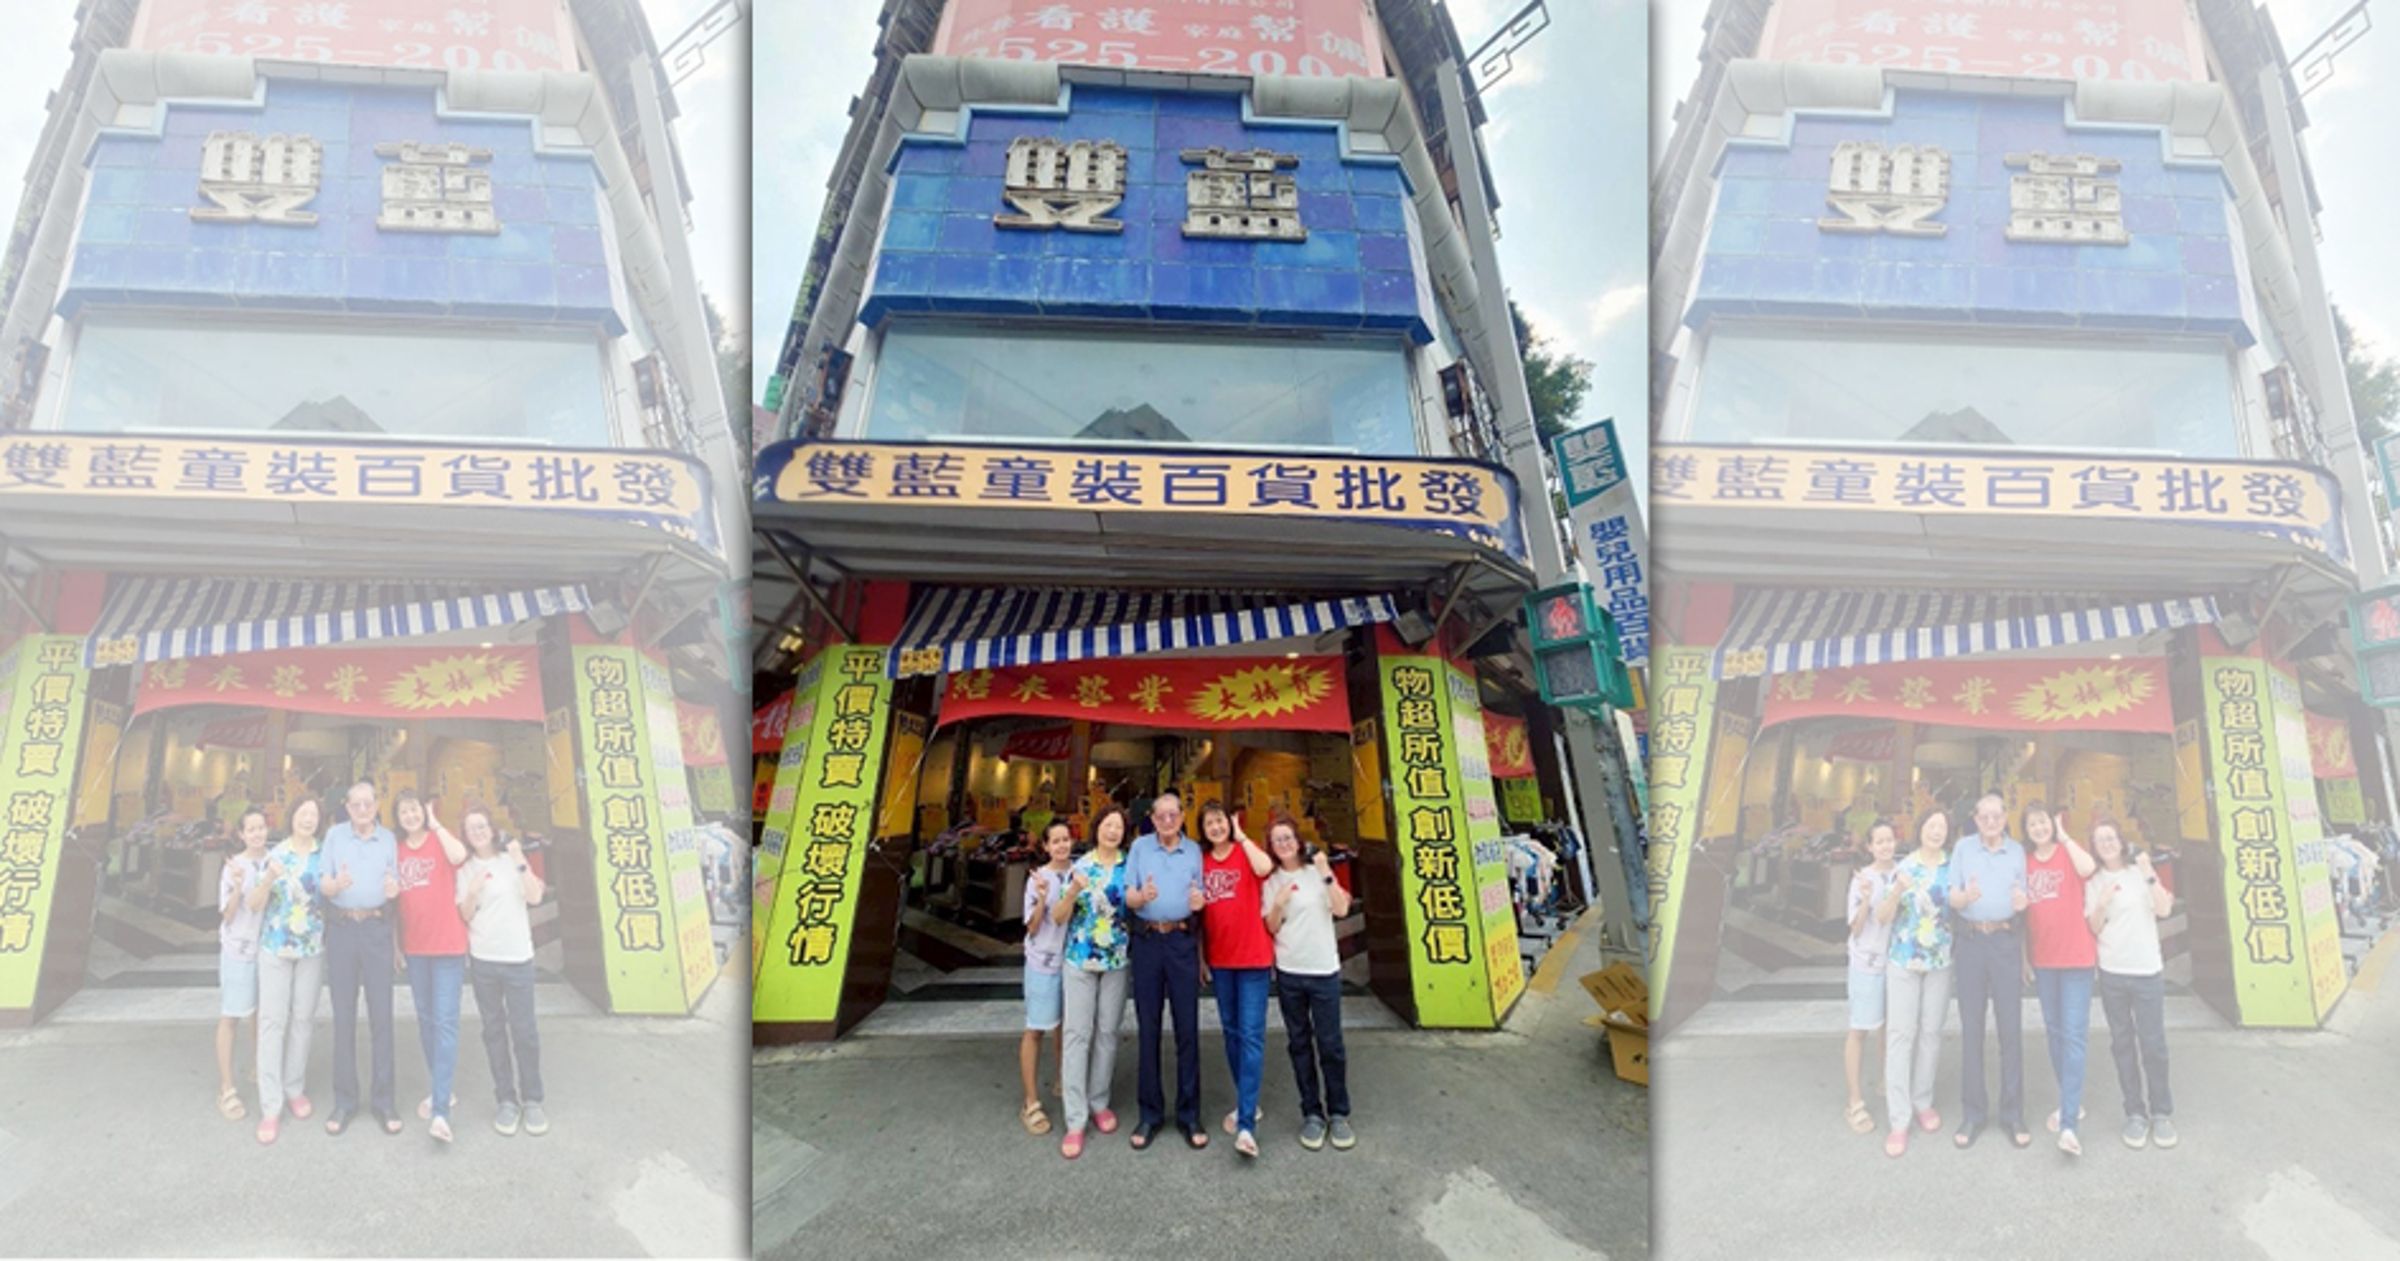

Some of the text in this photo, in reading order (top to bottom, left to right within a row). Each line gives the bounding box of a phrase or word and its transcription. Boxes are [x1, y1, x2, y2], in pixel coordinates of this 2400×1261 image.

[1023, 4, 1160, 37] 看護
[190, 131, 504, 234] 雙藍
[994, 137, 1310, 241] 雙藍
[1818, 141, 2133, 245] 雙藍
[0, 441, 679, 509] 雙藍童裝百貨批發
[799, 450, 1486, 518] 雙藍童裝百貨批發
[16, 641, 78, 777] 平價特賣
[585, 657, 642, 788] 物超所值
[819, 651, 881, 788] 平價特賣
[1392, 667, 1449, 799] 物超所值
[2214, 668, 2271, 800] 物超所值
[602, 794, 663, 951] 創新低價
[789, 802, 858, 966] 破壞行情
[1409, 805, 1470, 964] 創新低價
[2231, 806, 2292, 964] 創新低價
